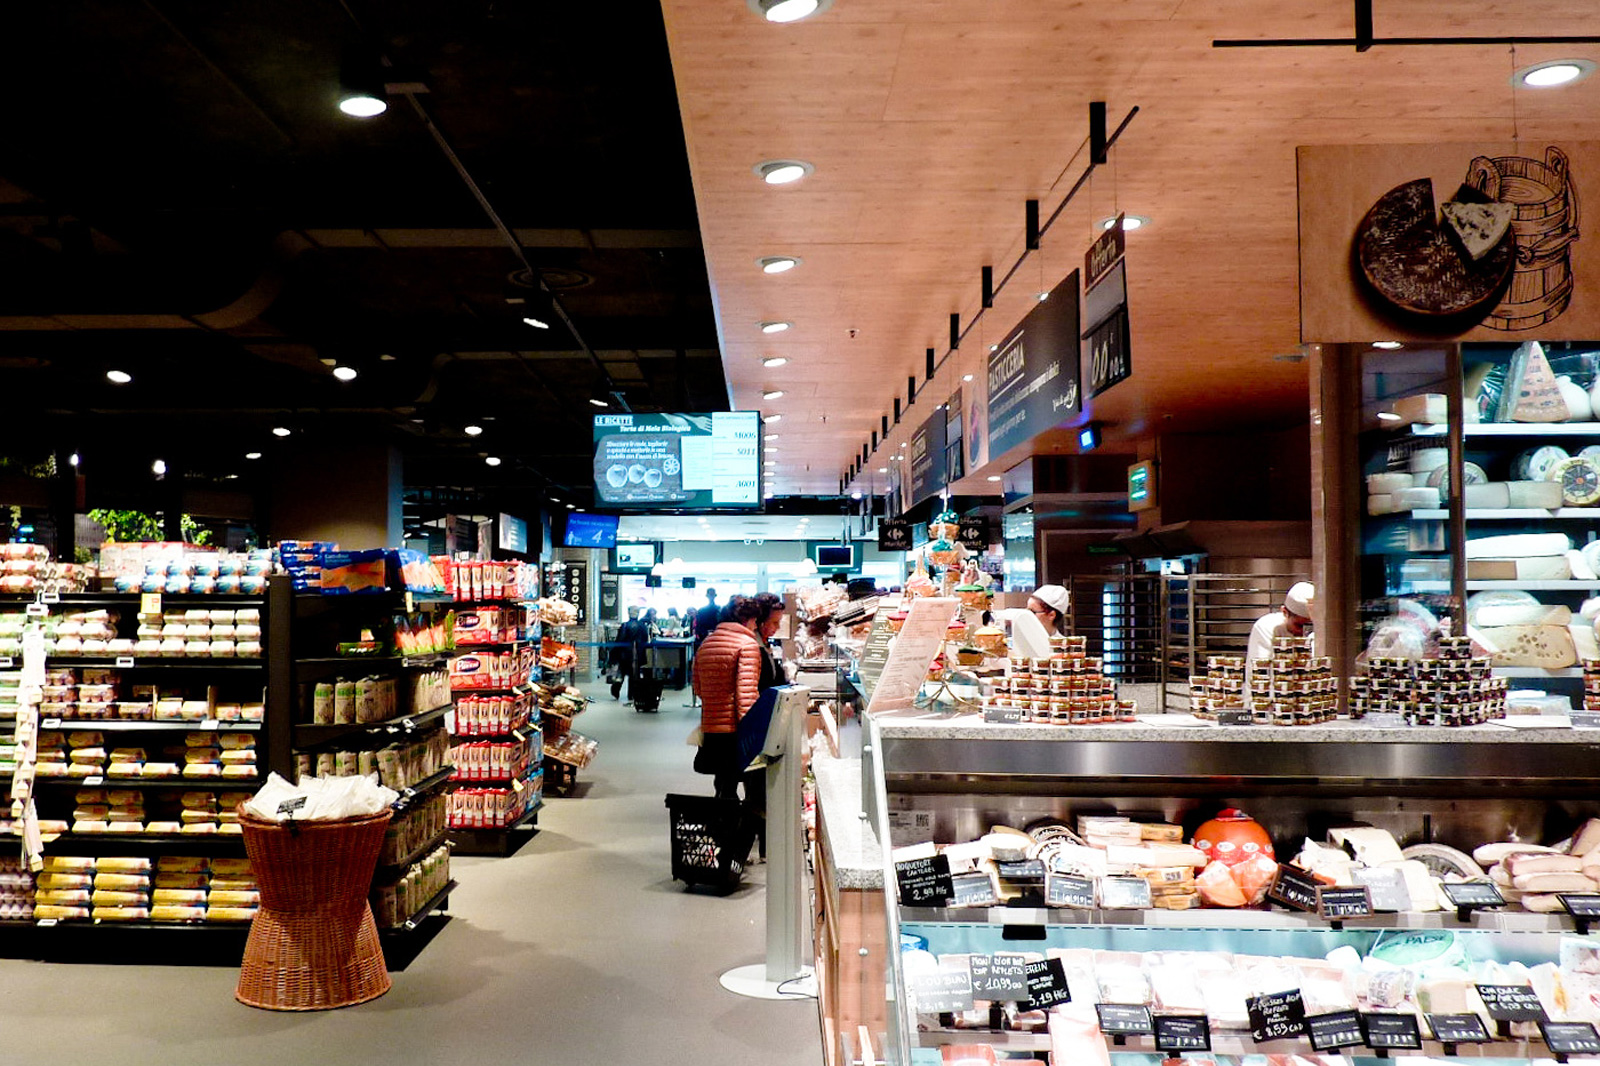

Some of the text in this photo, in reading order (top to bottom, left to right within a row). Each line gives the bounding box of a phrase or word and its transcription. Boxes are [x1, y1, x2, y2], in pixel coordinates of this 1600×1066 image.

[989, 342, 1025, 394] PASTICCERIA
[605, 416, 633, 425] RICETTE
[592, 530, 603, 543] 4
